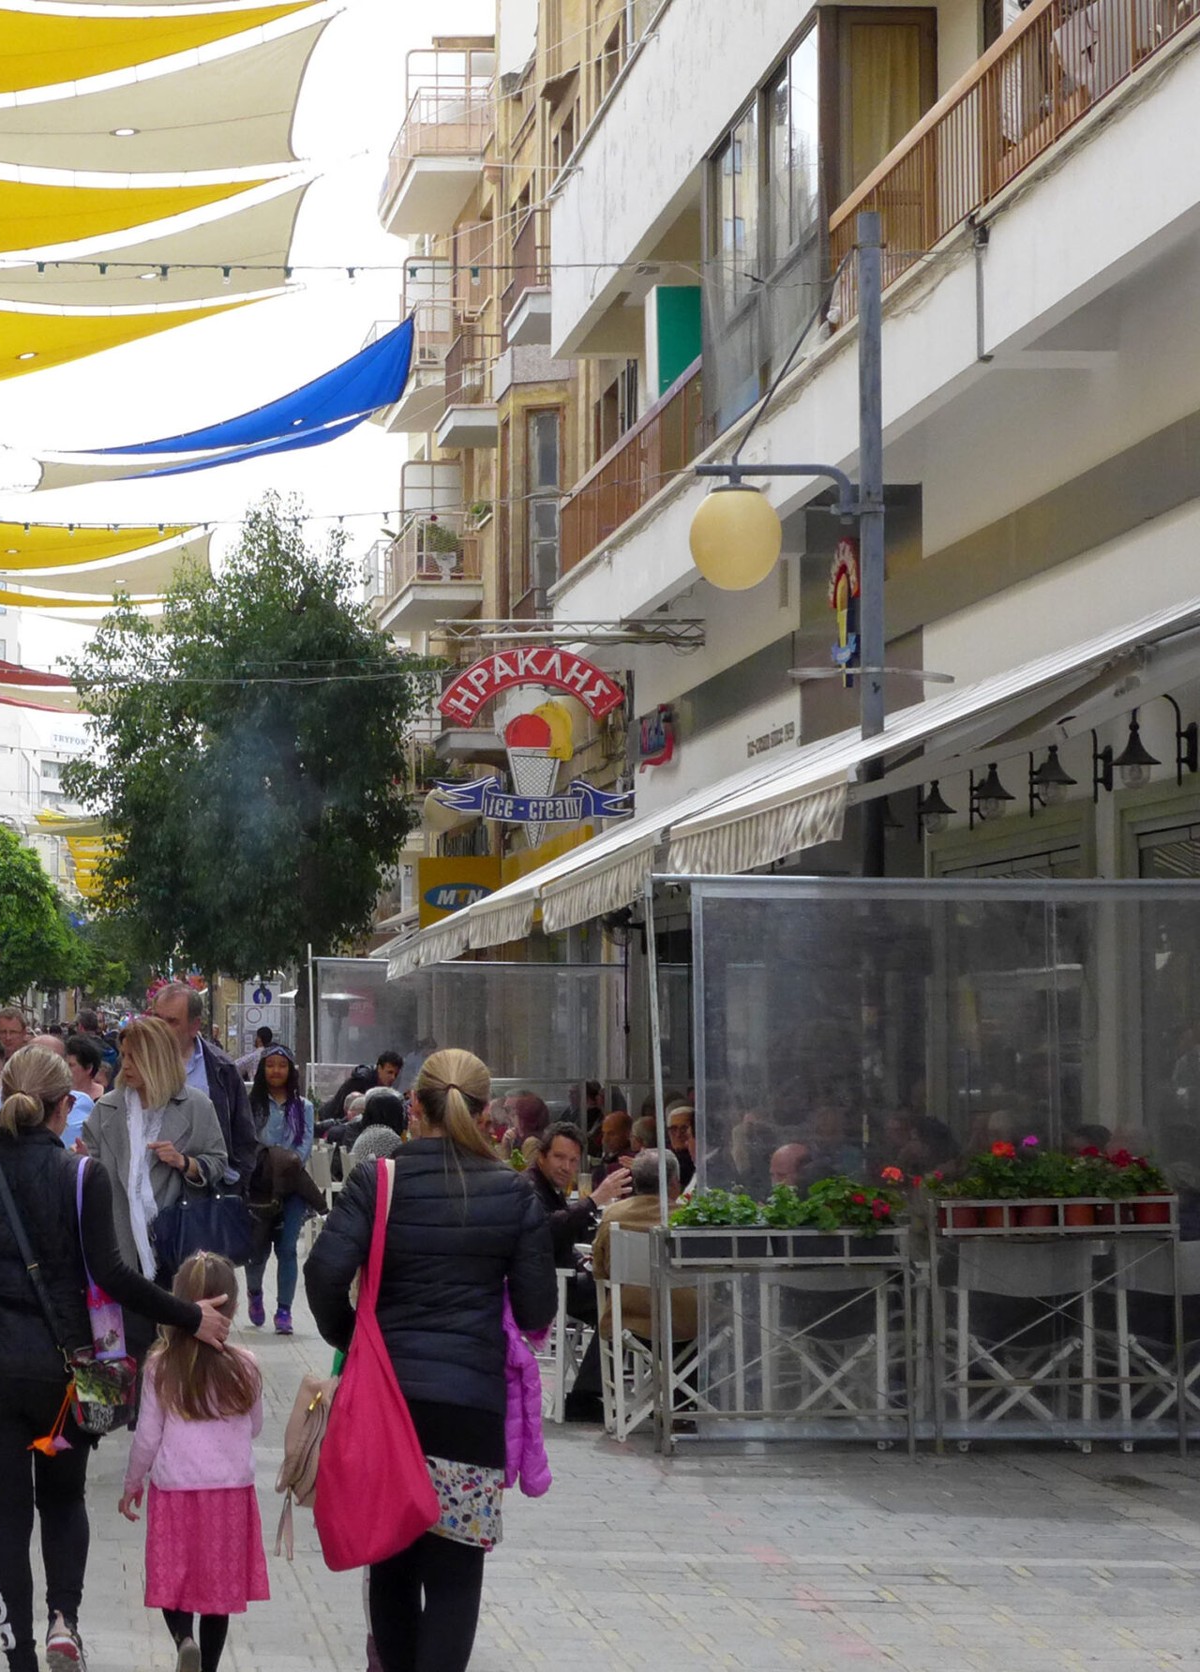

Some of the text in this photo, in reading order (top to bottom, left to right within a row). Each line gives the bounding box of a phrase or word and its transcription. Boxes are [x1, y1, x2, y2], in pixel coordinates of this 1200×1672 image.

[449, 649, 611, 715] ΗΡΑΚΛΗΣ
[529, 799, 579, 820] cream
[436, 889, 483, 905] MTN
